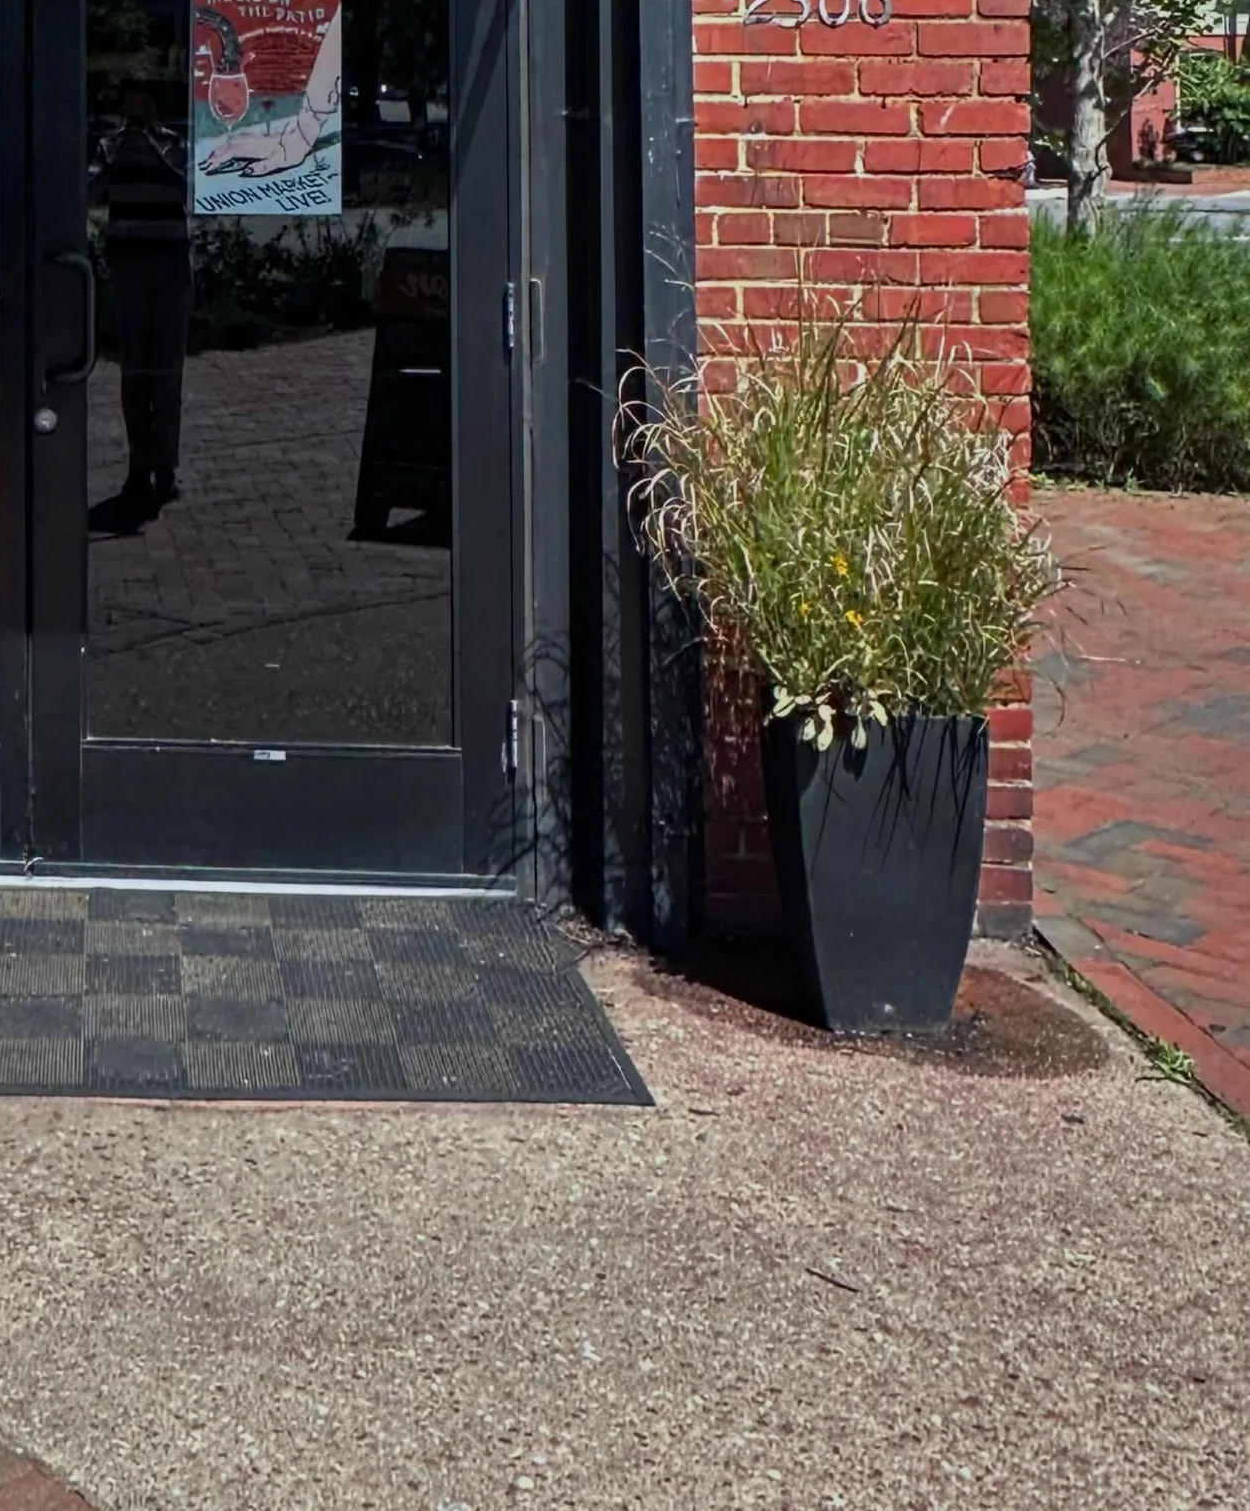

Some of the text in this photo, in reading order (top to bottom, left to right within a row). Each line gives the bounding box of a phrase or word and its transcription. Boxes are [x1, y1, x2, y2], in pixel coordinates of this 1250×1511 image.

[275, 7, 326, 23] PATIO
[196, 187, 263, 212] UNION
[275, 190, 332, 212] LIVE!
